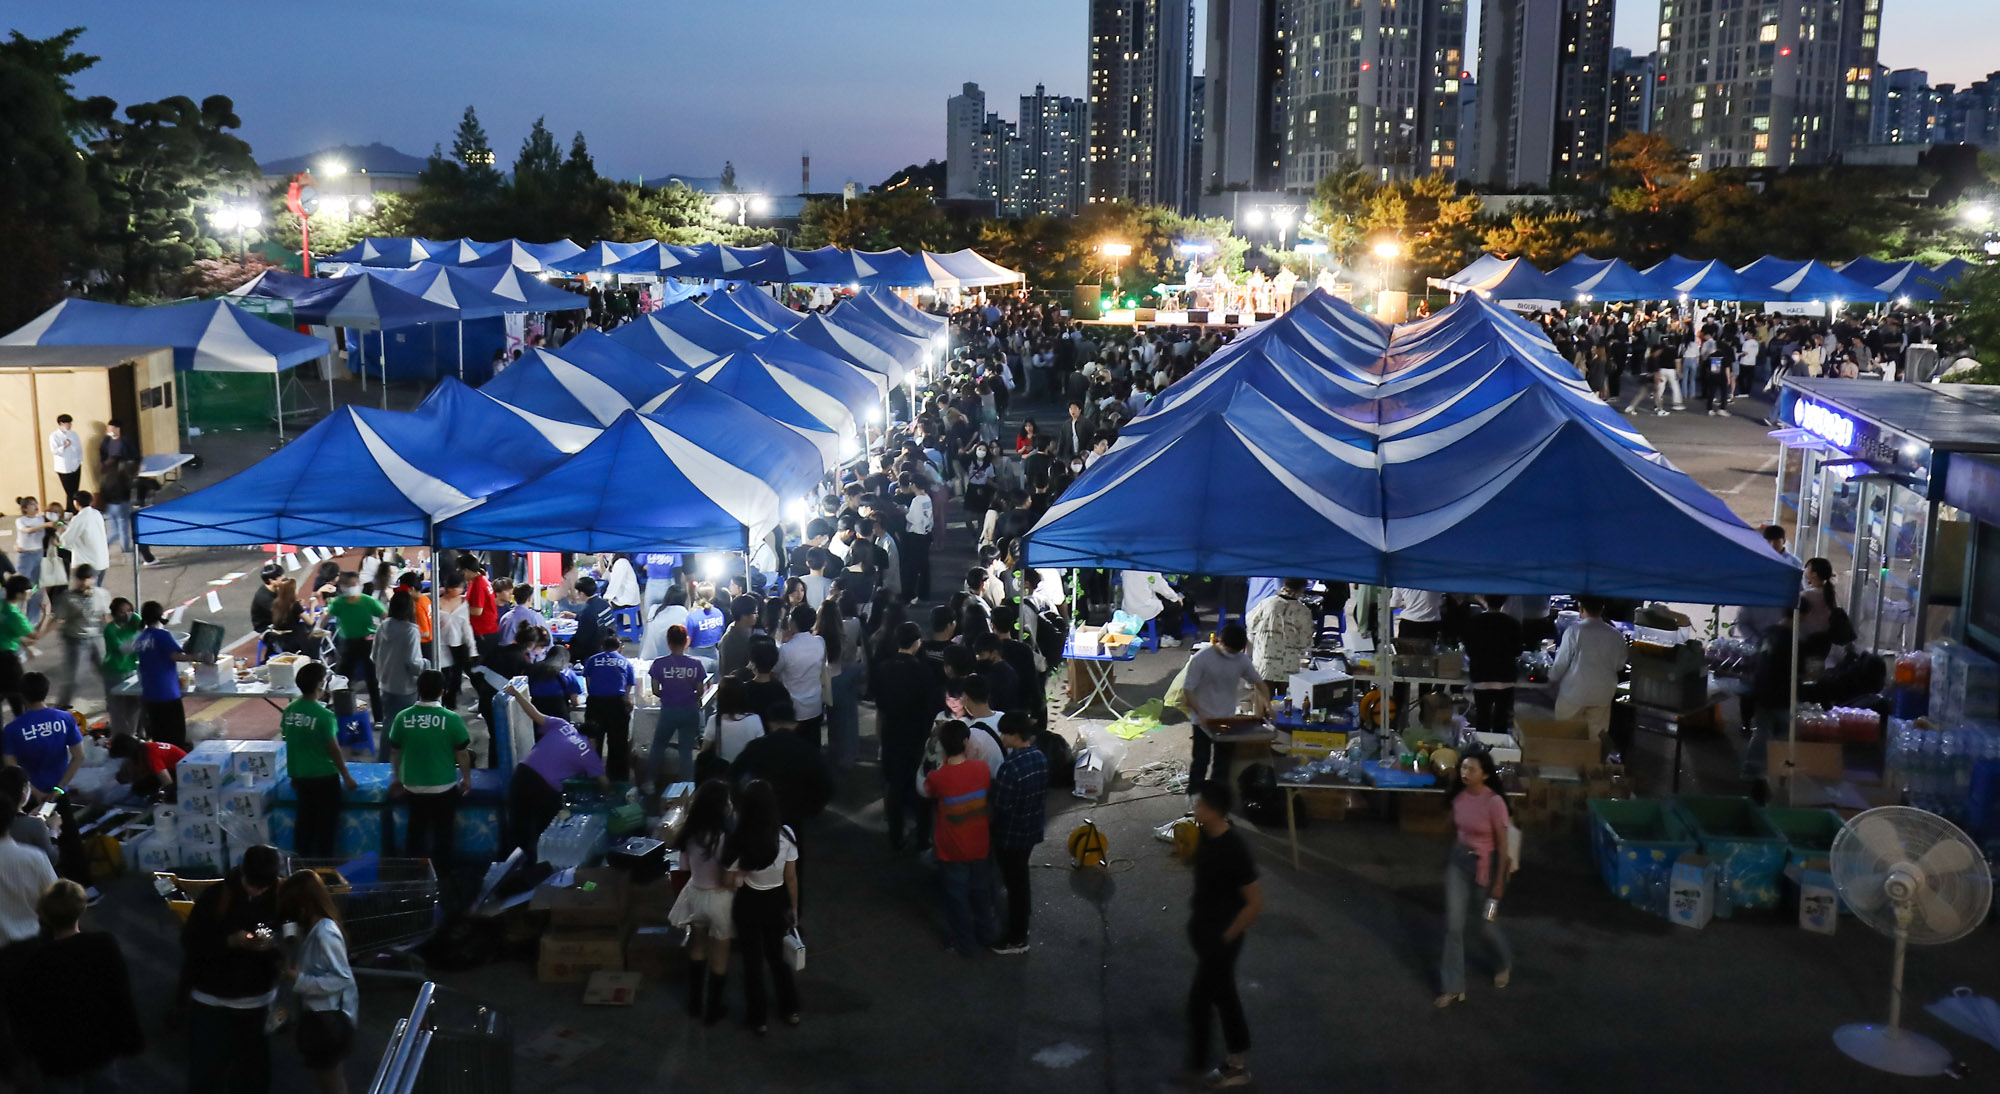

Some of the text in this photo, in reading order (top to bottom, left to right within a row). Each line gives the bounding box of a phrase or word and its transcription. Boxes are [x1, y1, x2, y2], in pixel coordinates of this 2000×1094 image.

[698, 616, 724, 631] 난쟁이
[594, 656, 629, 668] 난쟁이
[663, 667, 698, 680] 난쟁이
[285, 713, 317, 730] 난쟁이
[403, 714, 446, 730] 난쟁이
[22, 719, 67, 741] 난쟁이
